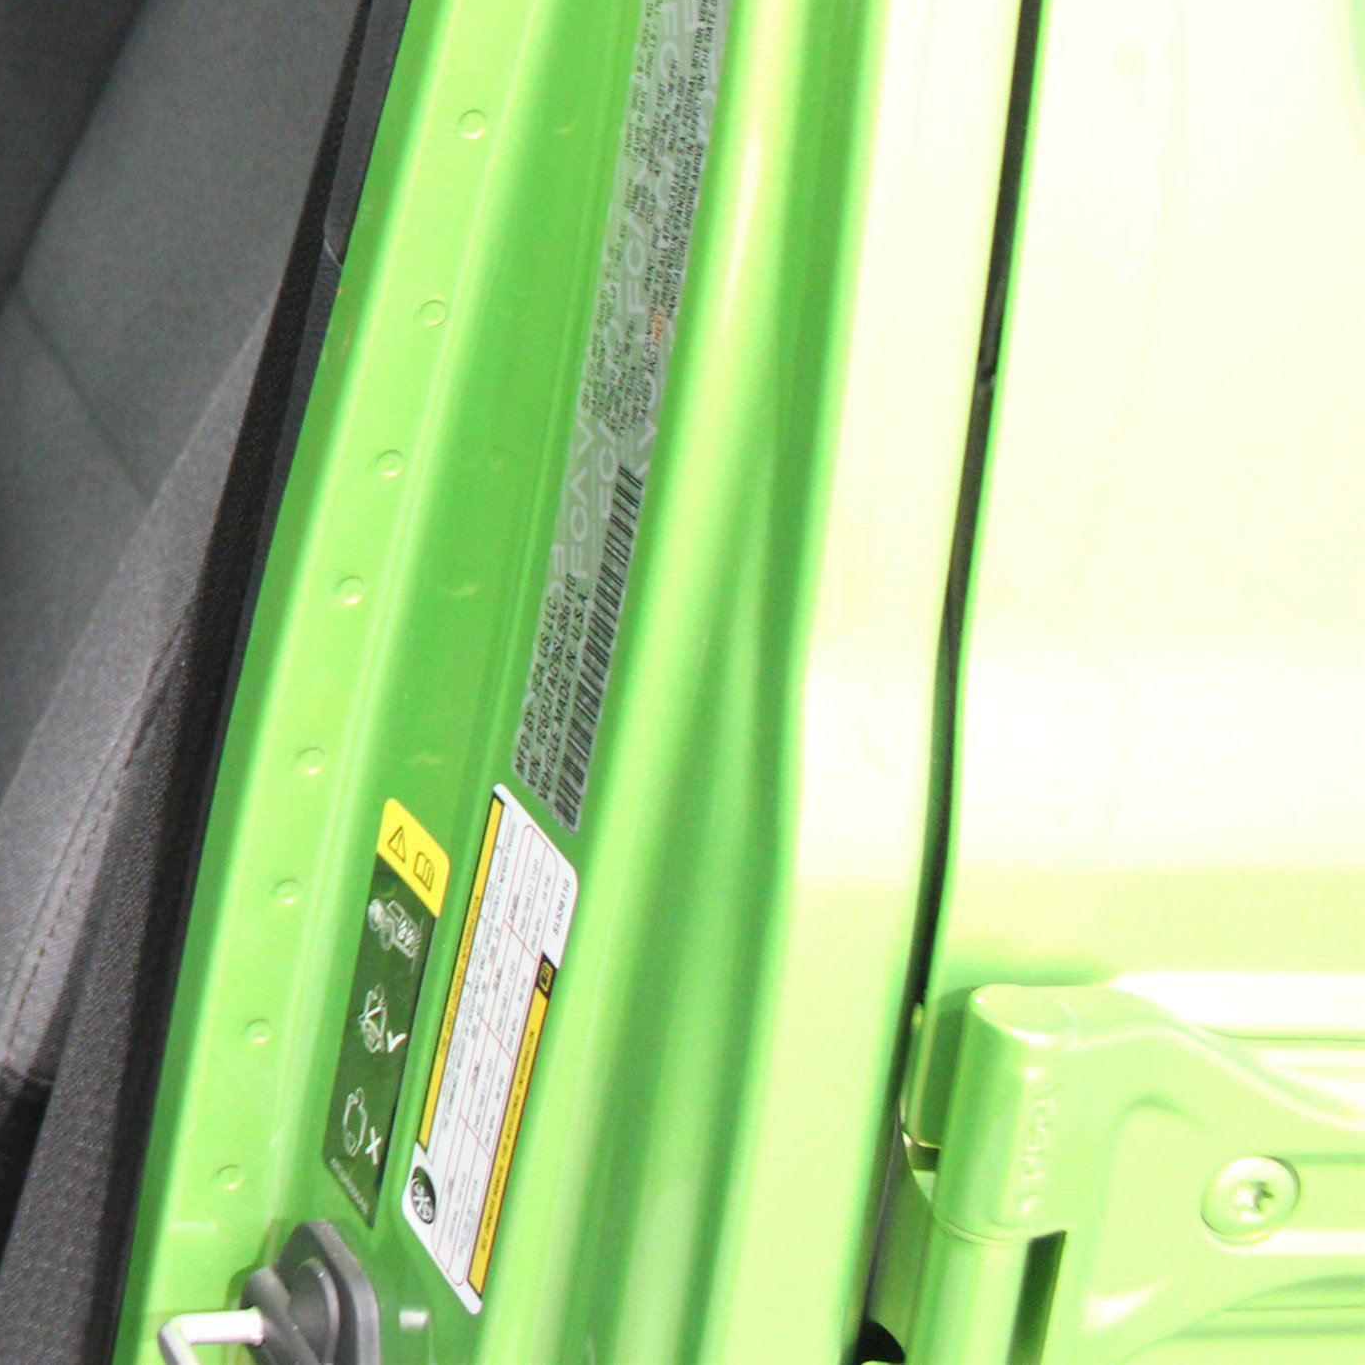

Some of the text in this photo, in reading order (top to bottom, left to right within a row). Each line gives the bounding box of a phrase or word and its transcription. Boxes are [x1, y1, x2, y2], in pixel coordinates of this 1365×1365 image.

[678, 69, 698, 130] FEDERAL
[671, 156, 693, 232] STANDARDS
[542, 594, 557, 632] LLC
[537, 629, 551, 661] US
[529, 659, 545, 698] FCA
[537, 726, 560, 805] VEHICLE
[552, 672, 571, 729] MADE
